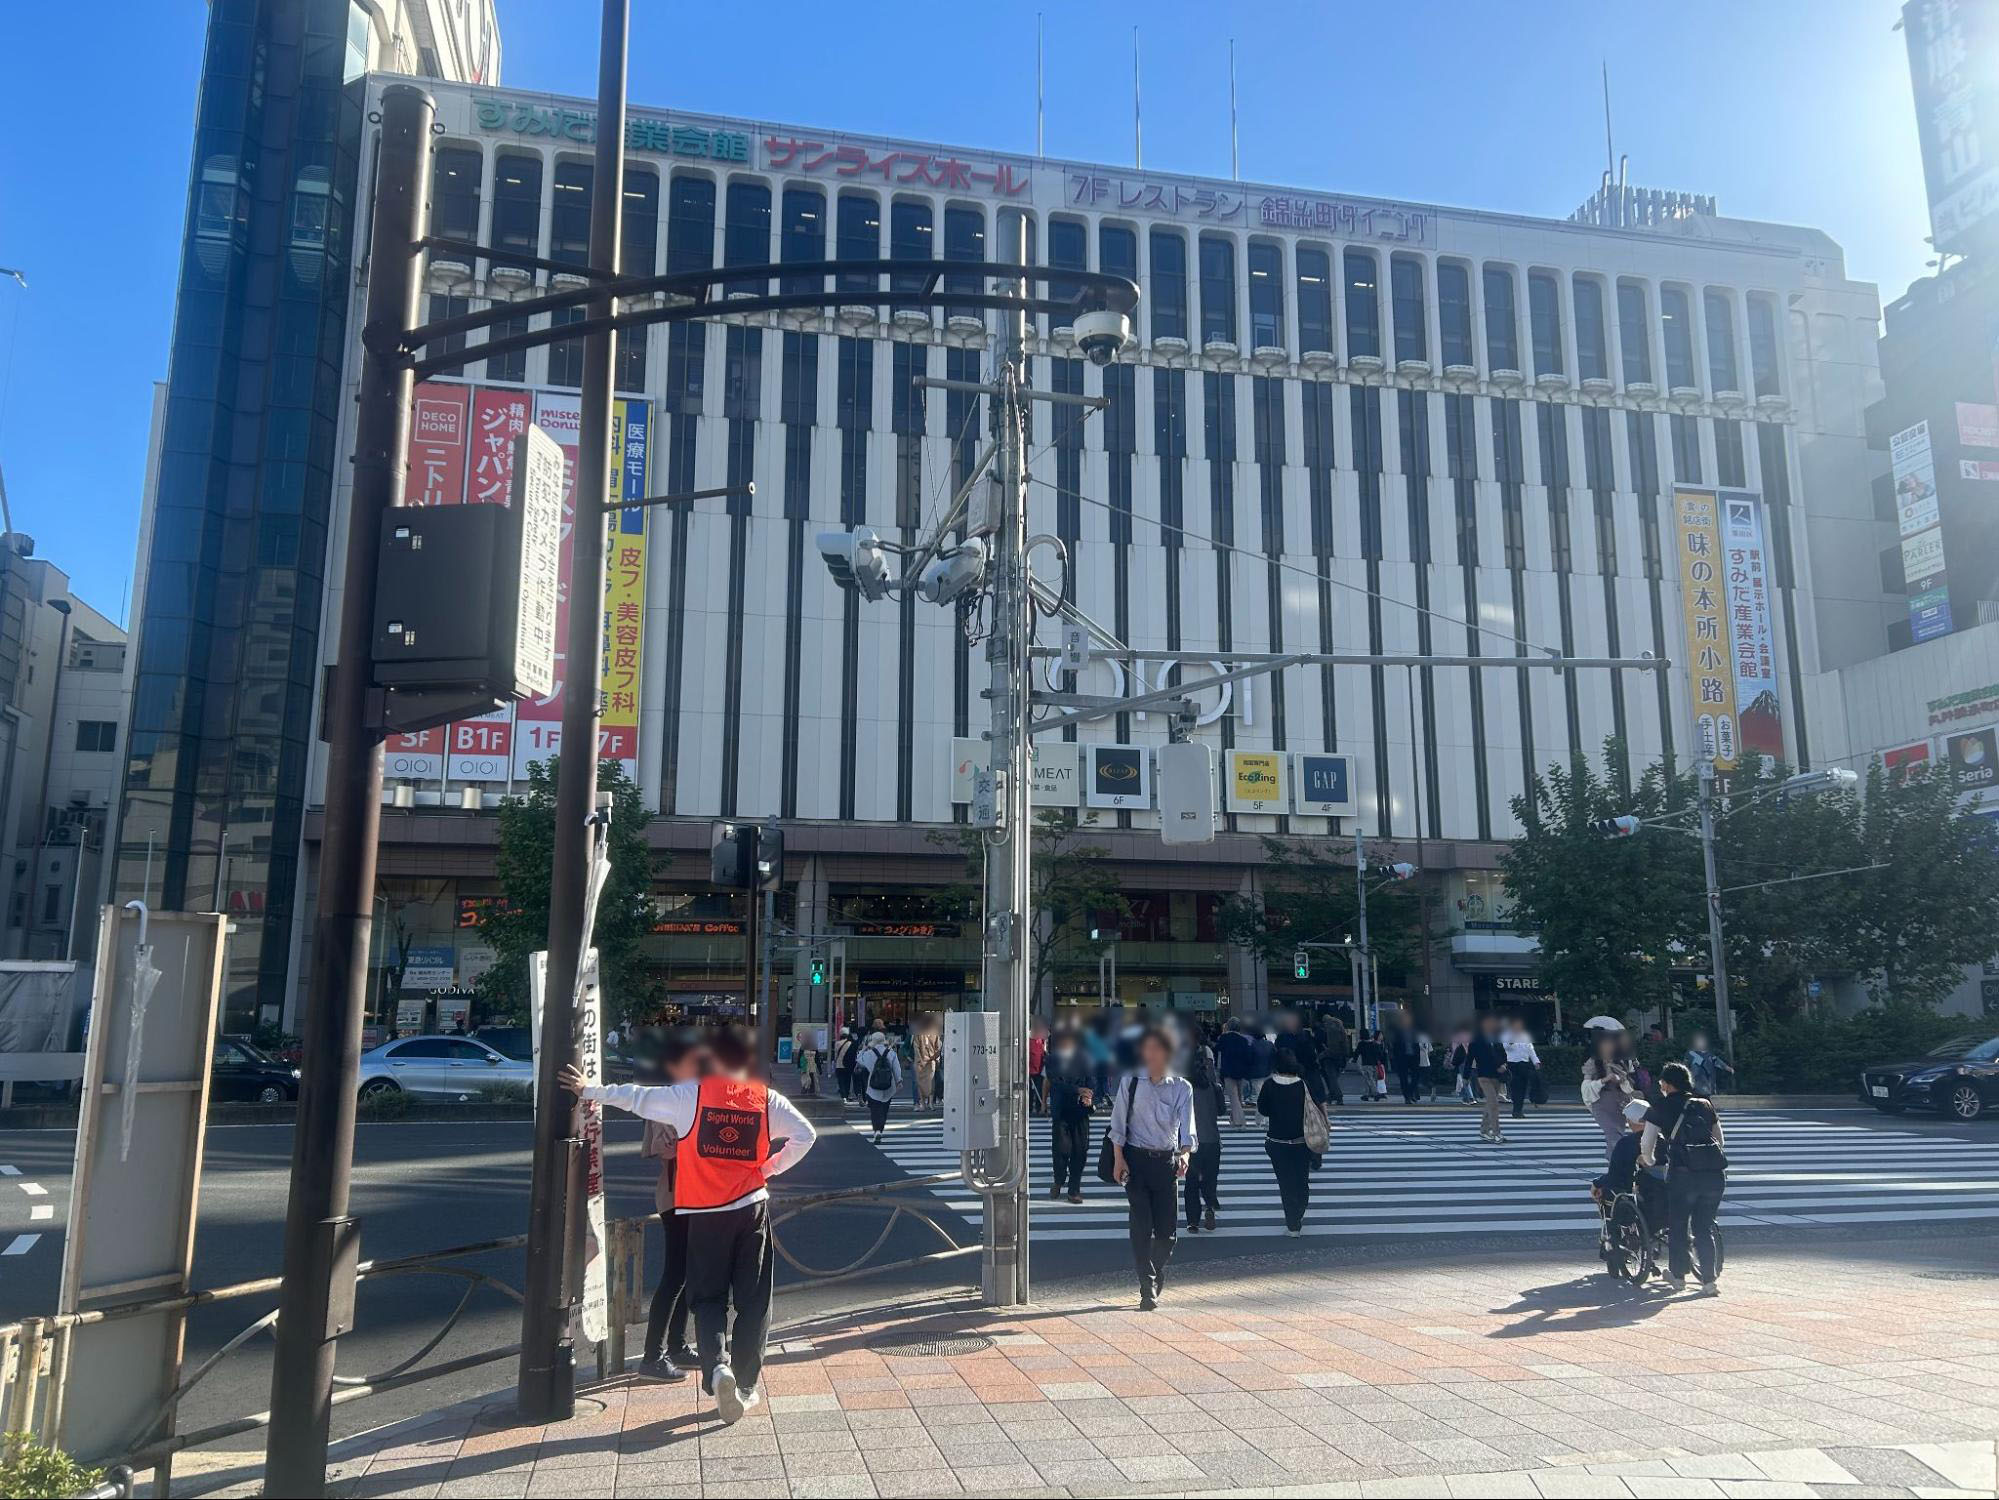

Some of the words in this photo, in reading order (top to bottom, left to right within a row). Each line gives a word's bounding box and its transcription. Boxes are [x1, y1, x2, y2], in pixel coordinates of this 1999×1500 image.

[474, 98, 749, 162] すみだ業会館
[766, 135, 1028, 196] サンライズホール
[1260, 195, 1429, 241] 錦糸町ダイニング
[420, 422, 456, 433] HOME
[422, 411, 457, 422] DECO
[541, 409, 580, 421] miste
[541, 418, 580, 430] Donu
[477, 408, 508, 503] ジャパン
[624, 422, 646, 513] 医療モール
[526, 466, 536, 516] Security
[524, 520, 533, 568] Camera
[519, 589, 530, 649] Operation
[1687, 532, 1725, 703] 味の本所小路
[1728, 548, 1759, 679] すみだ産業会館
[612, 547, 642, 714] 皮フ・美容皮フ科
[457, 725, 504, 751] B1F
[529, 725, 561, 750] 1F
[1719, 719, 1732, 758] お菓子
[1034, 767, 1072, 780] MEAT
[1313, 770, 1337, 790] GAP
[1957, 766, 1993, 783] Seria
[978, 779, 991, 821] 交通
[1113, 796, 1124, 805] 6F
[1252, 801, 1264, 810] 5F
[1321, 803, 1332, 812] 4F
[704, 923, 739, 933] Coffee
[972, 1044, 997, 1056] 773-34
[706, 1111, 729, 1126] Sight
[730, 1112, 756, 1126] World
[702, 1143, 752, 1157] Volunteer
